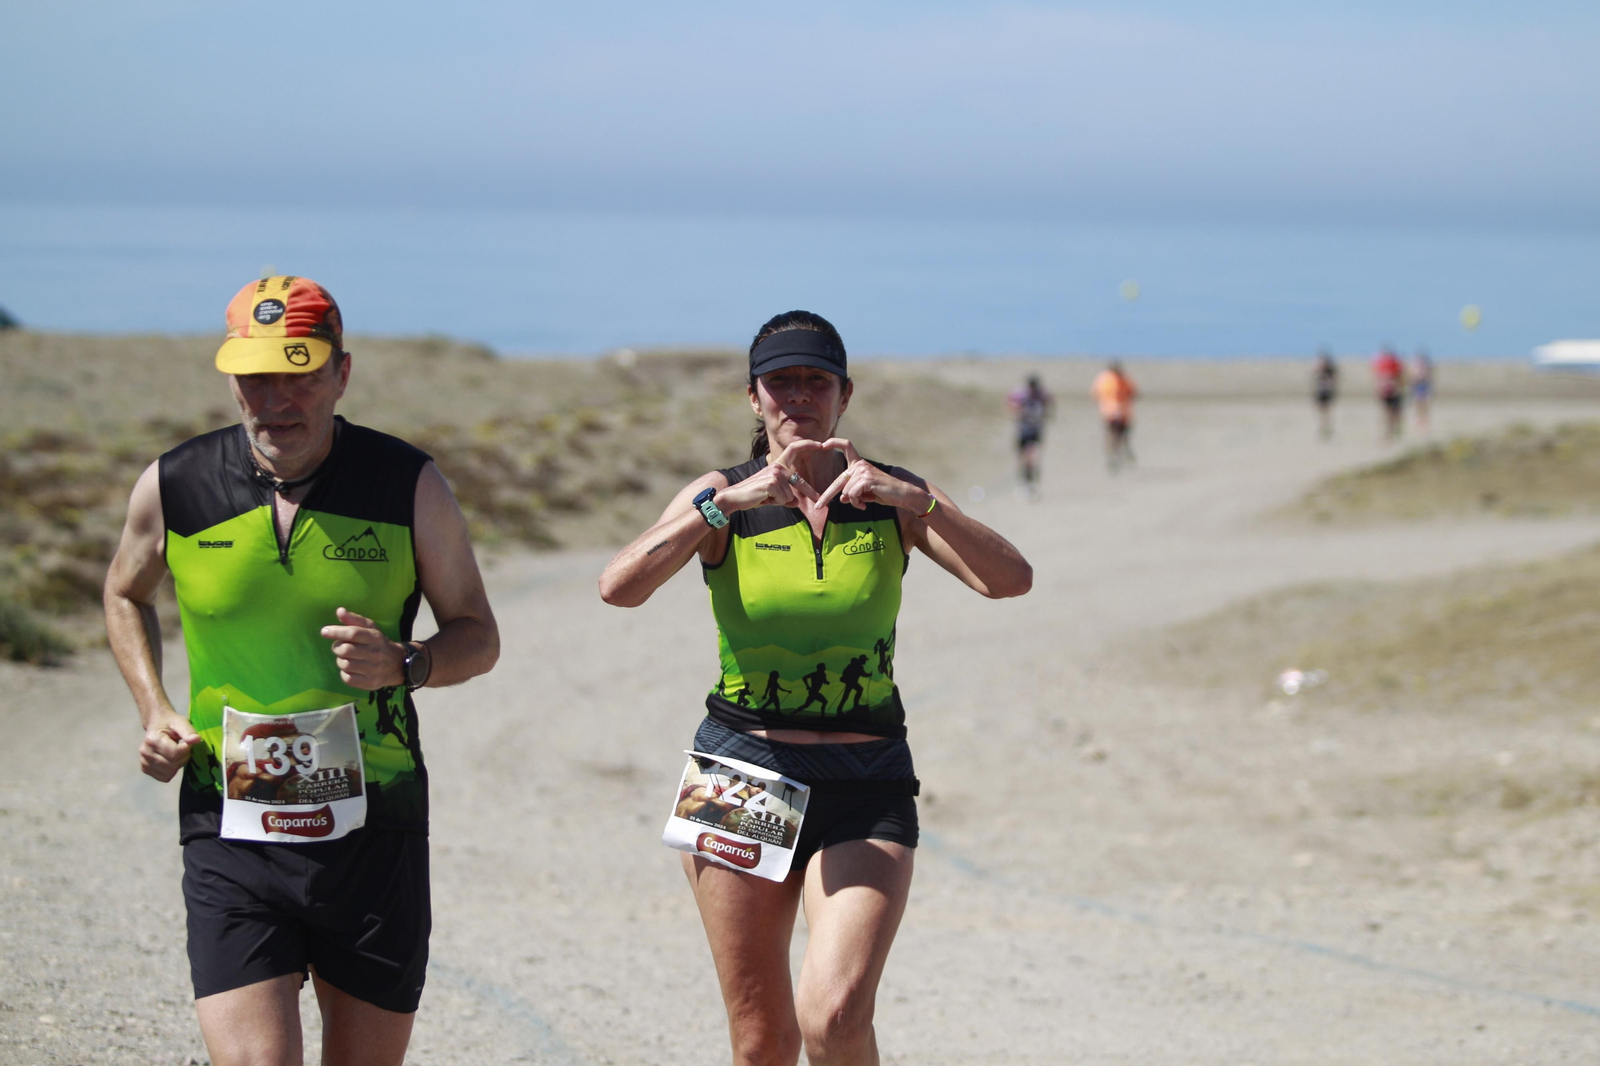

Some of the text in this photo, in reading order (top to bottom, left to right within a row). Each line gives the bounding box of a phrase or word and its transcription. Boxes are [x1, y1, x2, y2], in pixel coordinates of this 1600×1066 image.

[240, 734, 320, 776] 139
[297, 767, 348, 784] XIII
[297, 778, 349, 789] CARRERA
[298, 783, 349, 794] POPULAR
[311, 788, 350, 798] ESPARTANOS
[704, 762, 774, 812] 122
[741, 816, 786, 832] CARRERA
[742, 807, 787, 828] XIII
[736, 829, 751, 837] DEL
[740, 821, 785, 837] POPULAR
[748, 827, 784, 841] ESPARTANOS
